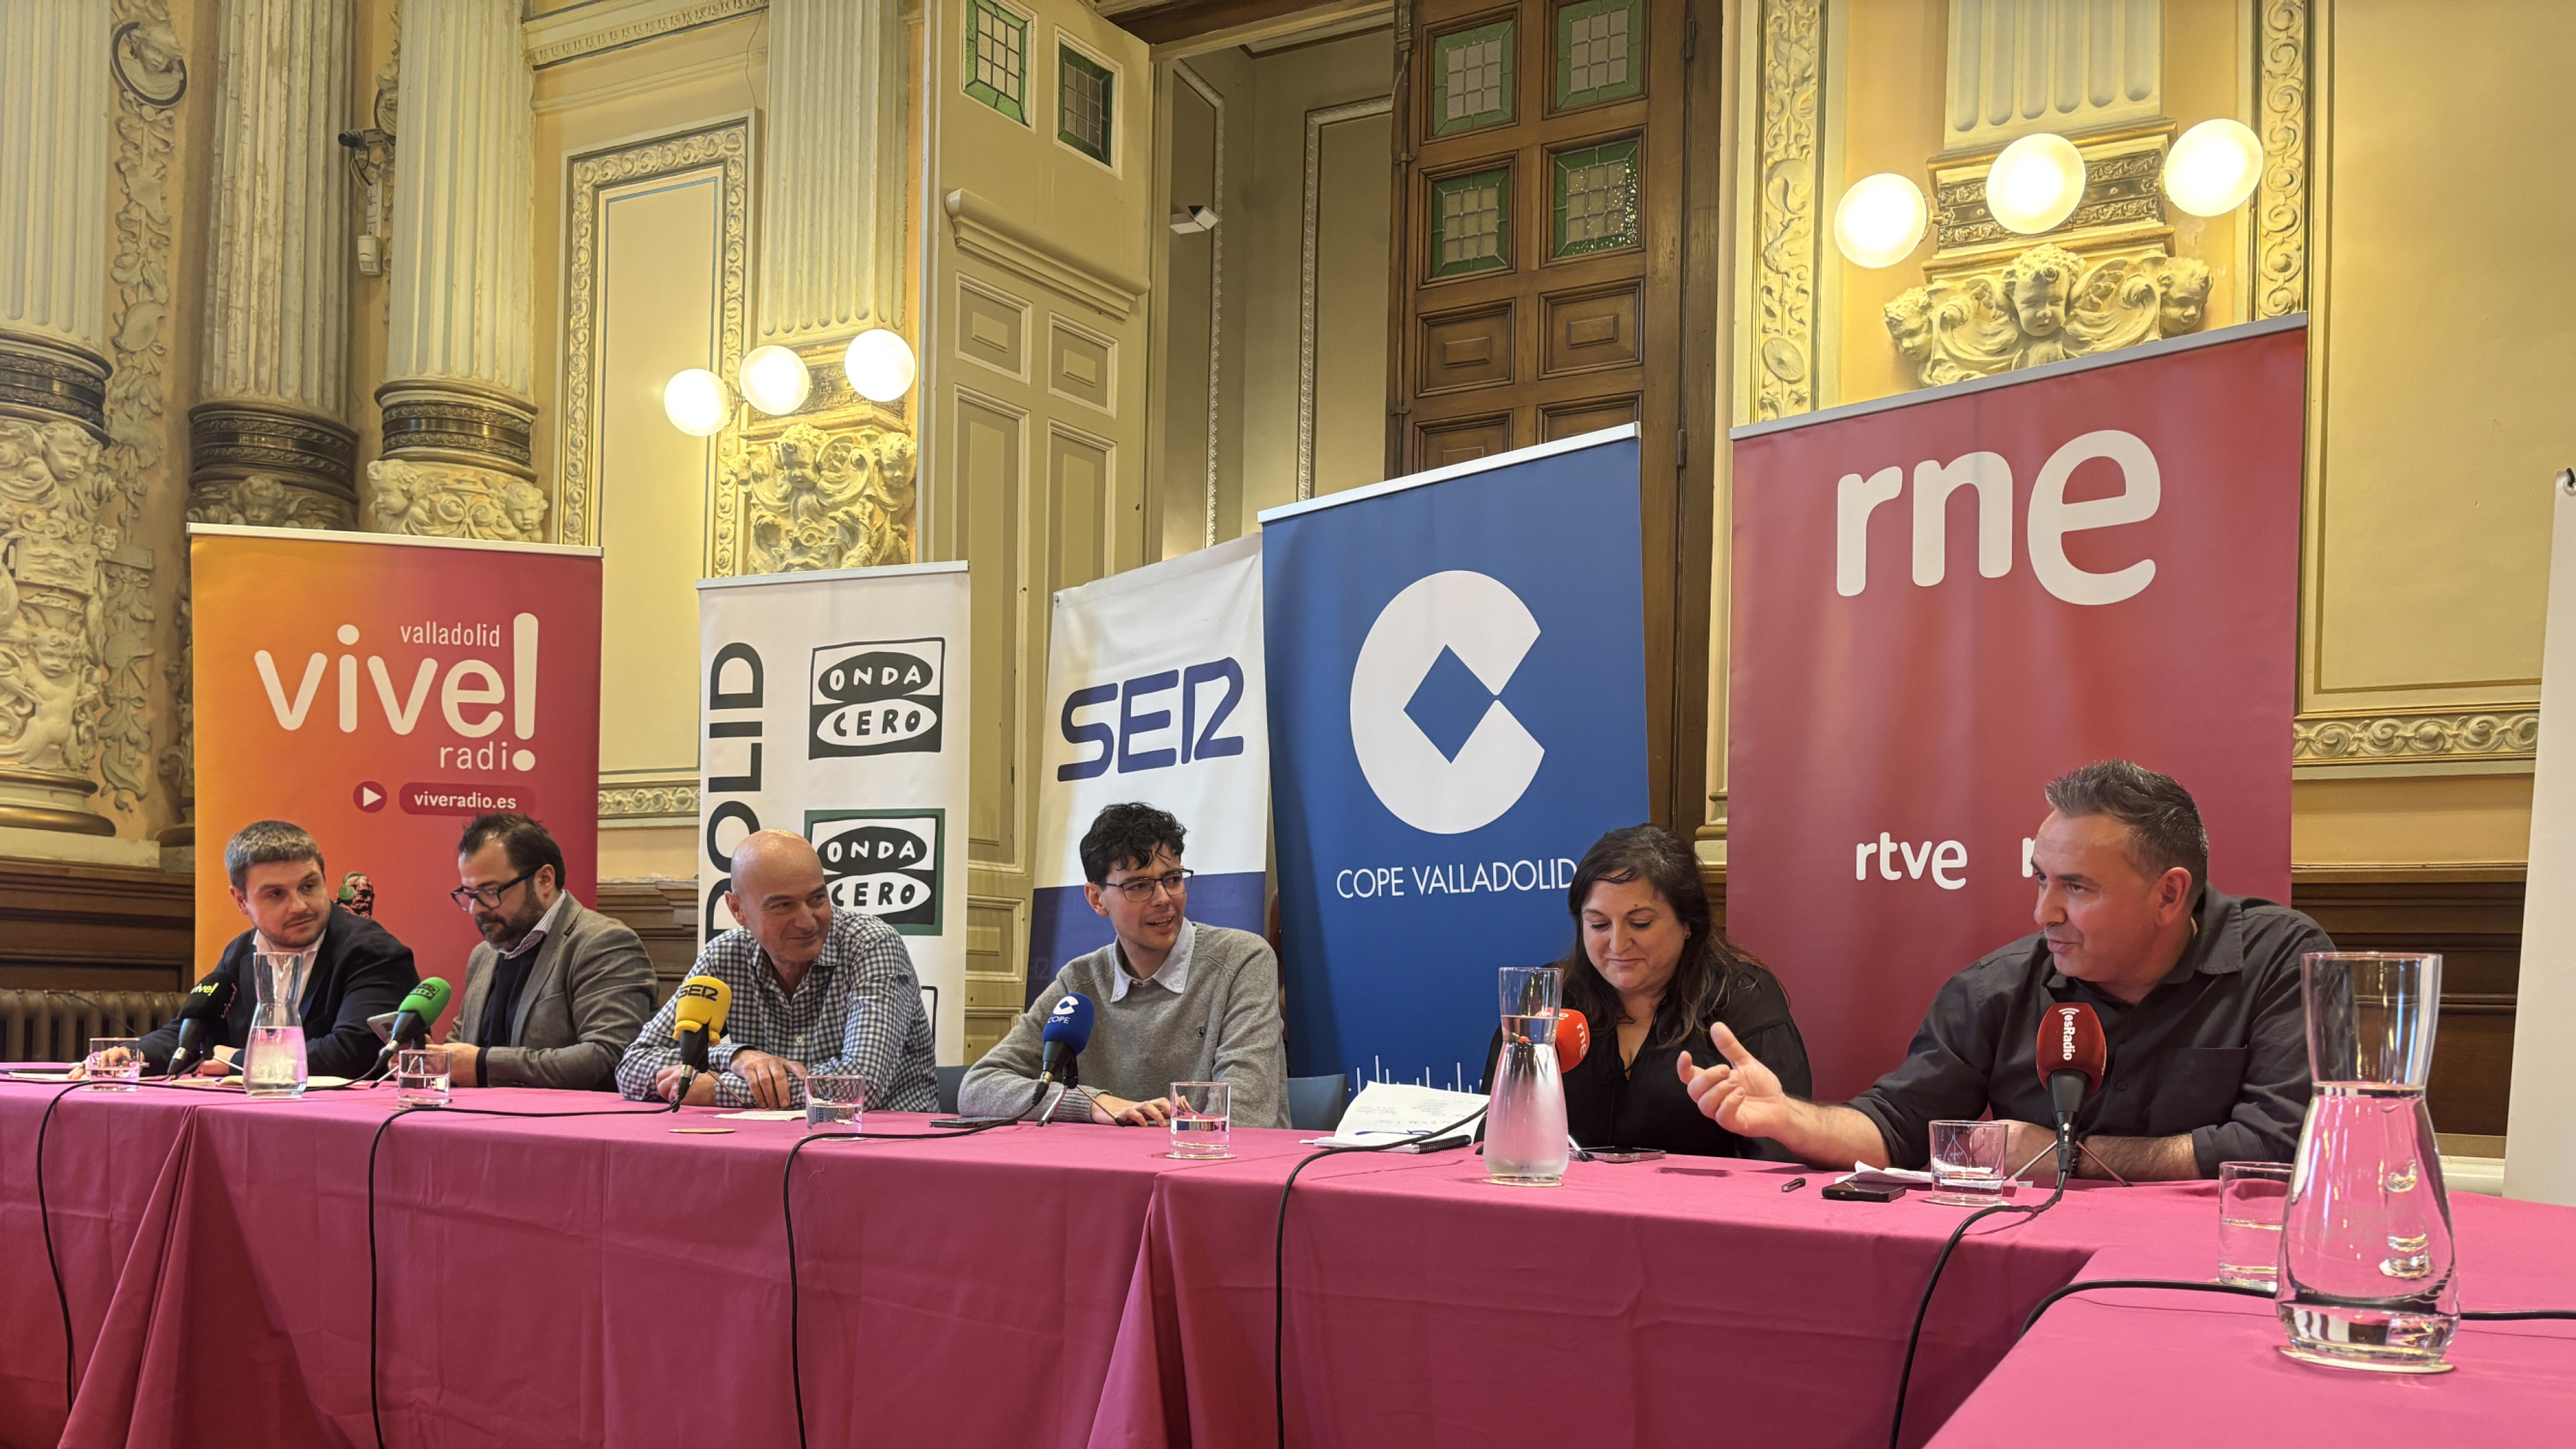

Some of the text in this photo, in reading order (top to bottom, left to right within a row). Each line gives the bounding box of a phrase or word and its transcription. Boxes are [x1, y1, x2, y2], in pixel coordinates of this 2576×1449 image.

[1837, 430, 2161, 605] rne
[400, 621, 500, 647] valladolid
[254, 612, 538, 740] vive!
[830, 665, 920, 691] ONDA
[833, 709, 920, 737] CERO
[1057, 657, 1244, 782] SER
[414, 791, 517, 810] viveradio.es
[827, 841, 916, 862] ONDA
[1856, 832, 1968, 890] rtve
[832, 882, 915, 906] CERO
[1336, 858, 1577, 898] COPE VALLADOLID
[2063, 1014, 2076, 1061] esRadio
